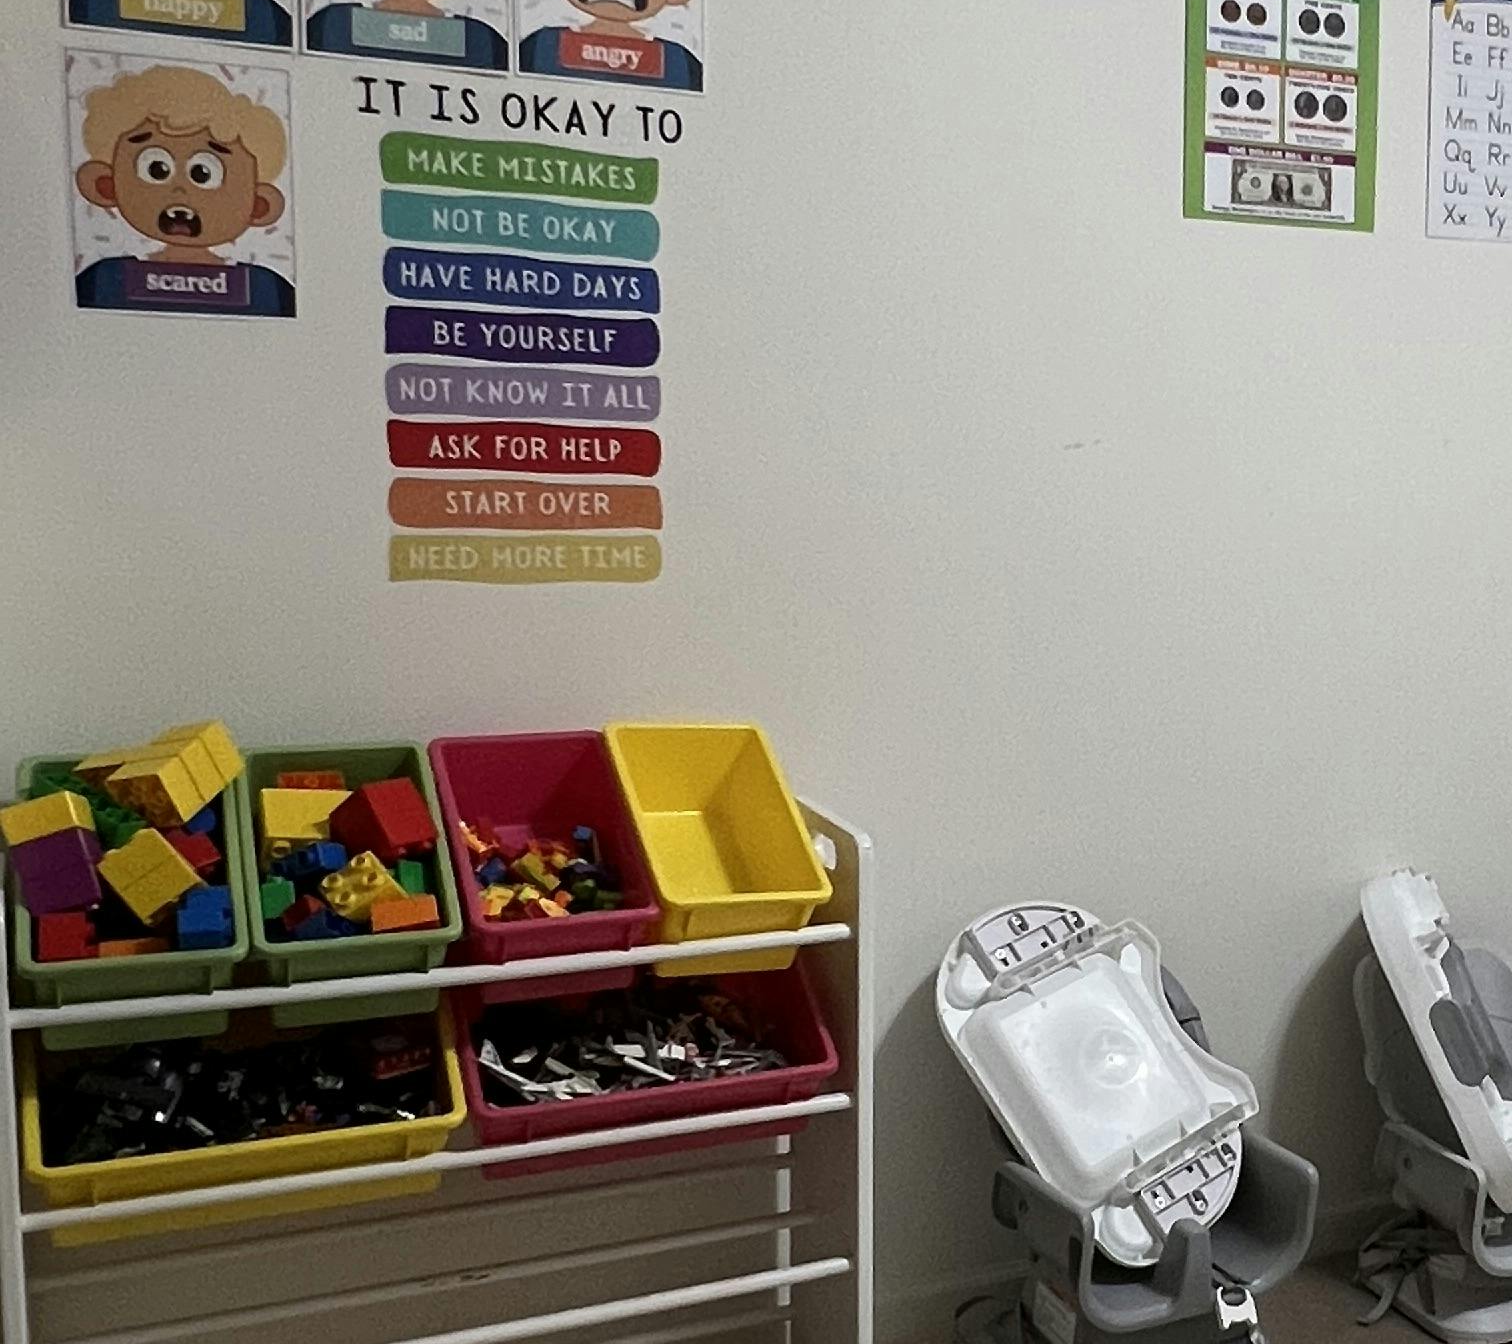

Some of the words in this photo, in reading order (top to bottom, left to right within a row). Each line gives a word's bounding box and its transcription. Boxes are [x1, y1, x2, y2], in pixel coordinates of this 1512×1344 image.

[388, 20, 428, 43] sad
[1451, 9, 1475, 34] Aa
[1486, 13, 1510, 38] Bb
[581, 43, 643, 69] angry
[1452, 41, 1473, 66] Ee
[1487, 46, 1508, 70] Ff
[355, 76, 406, 116] IT
[429, 84, 480, 124] IS
[501, 93, 616, 137] OKAY
[635, 106, 683, 143] TO
[1445, 106, 1478, 131] Mm
[1487, 112, 1512, 135] Nn
[407, 149, 486, 178] MAKE
[499, 157, 637, 191] MISTAKES
[1444, 139, 1476, 173] Qq
[1487, 143, 1511, 166] Rr
[1443, 171, 1468, 195] Uu
[1484, 175, 1508, 197] Vv
[432, 207, 486, 234] NOT
[499, 212, 531, 239] BE
[543, 217, 617, 244] OKAY
[1443, 204, 1467, 225] Xx
[1485, 206, 1506, 237] Yy
[146, 272, 229, 294] scared
[400, 261, 473, 290] HAVE
[486, 267, 560, 296] HARD
[573, 273, 641, 300] DAYS
[432, 320, 468, 347] BE
[480, 323, 618, 353] YOURSELF
[399, 377, 451, 403] NOT
[466, 378, 548, 405] KNOW
[561, 382, 593, 407] IT
[603, 384, 651, 410] ALL
[428, 434, 482, 460] ASK
[495, 436, 549, 461] FOR
[560, 437, 623, 462] HELP
[445, 490, 527, 515] START
[539, 492, 612, 516] OVER
[409, 545, 479, 570] NEED
[492, 545, 567, 569] MORE
[580, 545, 647, 569] TIME
